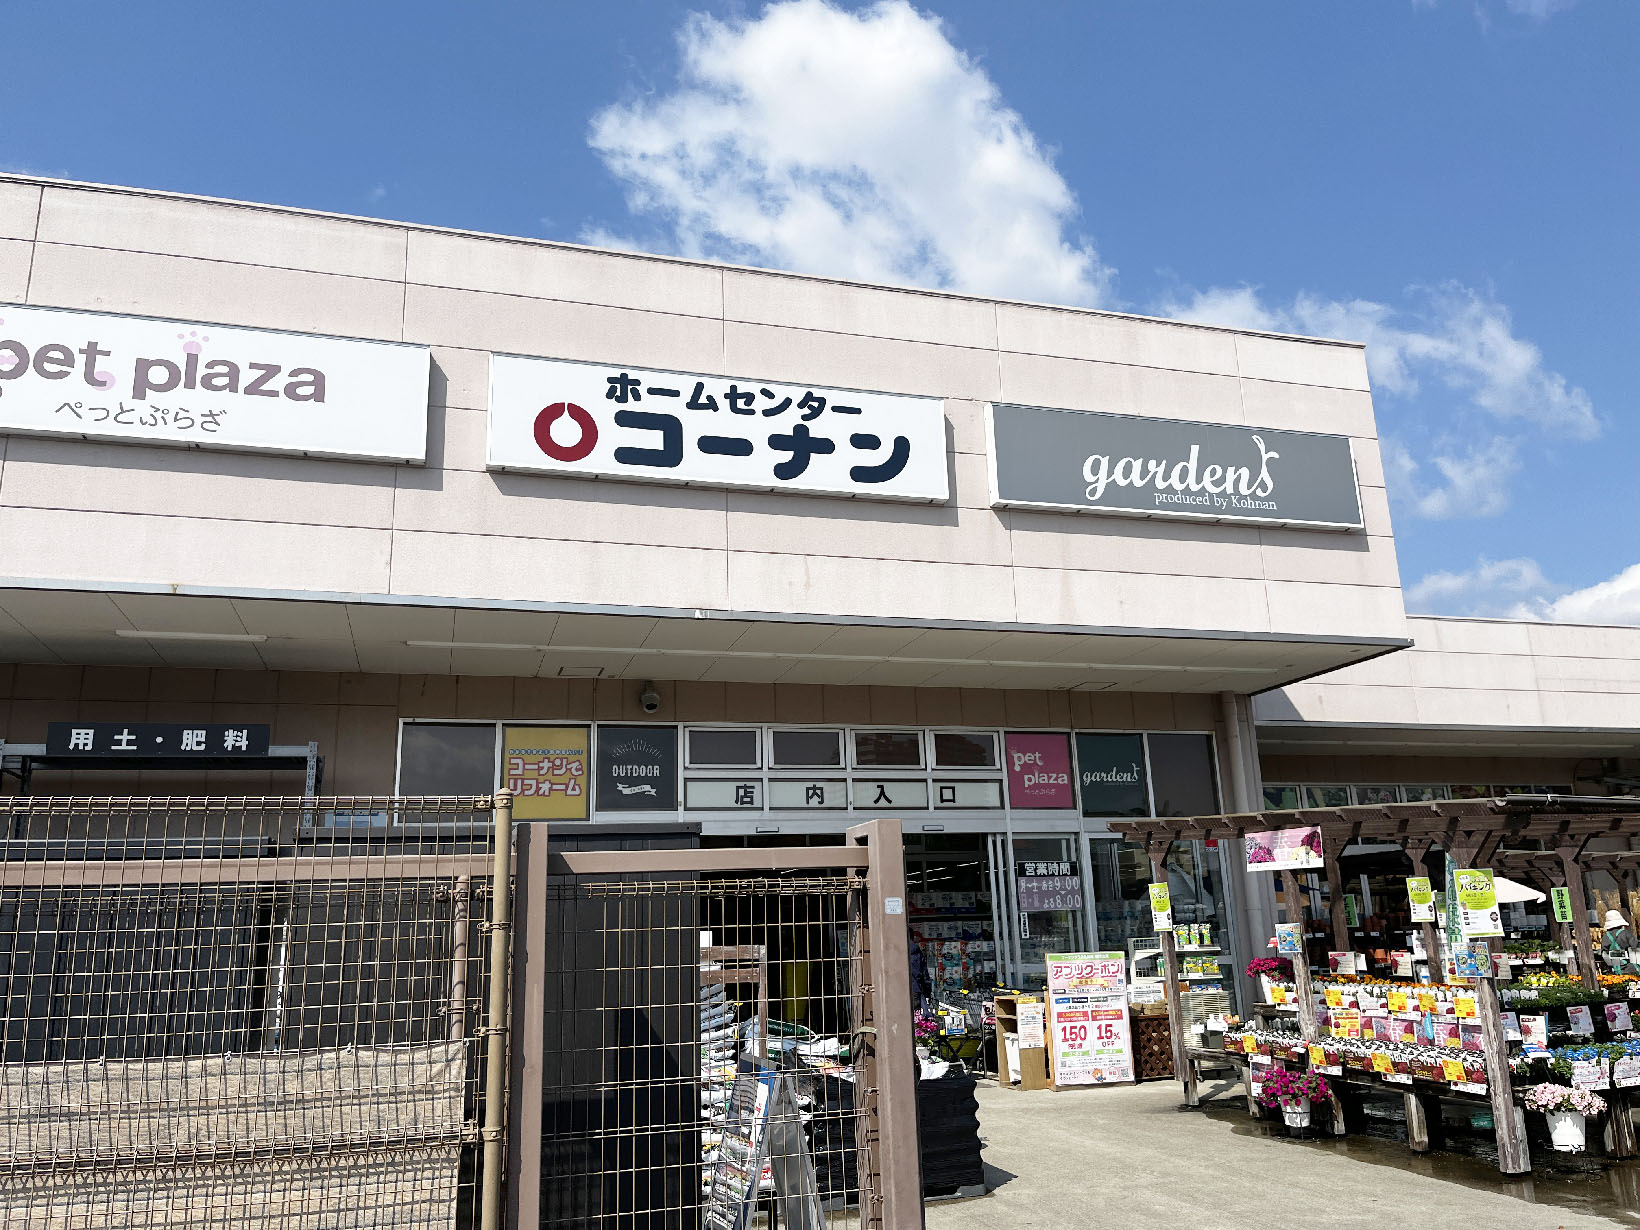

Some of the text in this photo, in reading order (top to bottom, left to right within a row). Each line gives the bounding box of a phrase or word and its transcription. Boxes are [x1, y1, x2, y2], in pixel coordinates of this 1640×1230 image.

[132, 352, 326, 403] plaza
[606, 372, 862, 421] ホームセンター
[55, 401, 228, 433] ぺっとぷらざ
[614, 410, 911, 483] コーナン
[1154, 492, 1278, 510] produced by Kohnan
[69, 728, 249, 752] 用土・肥料
[508, 757, 584, 776] コーナンで
[612, 765, 660, 777] OUTDOOR
[1013, 751, 1044, 772] pet
[508, 778, 583, 796] リフォーム
[1023, 771, 1068, 787] plaza
[734, 783, 956, 806] 店内入口
[1024, 862, 1071, 876] 営業時間
[1061, 1025, 1088, 1042] 150
[1101, 1040, 1115, 1048] OFF
